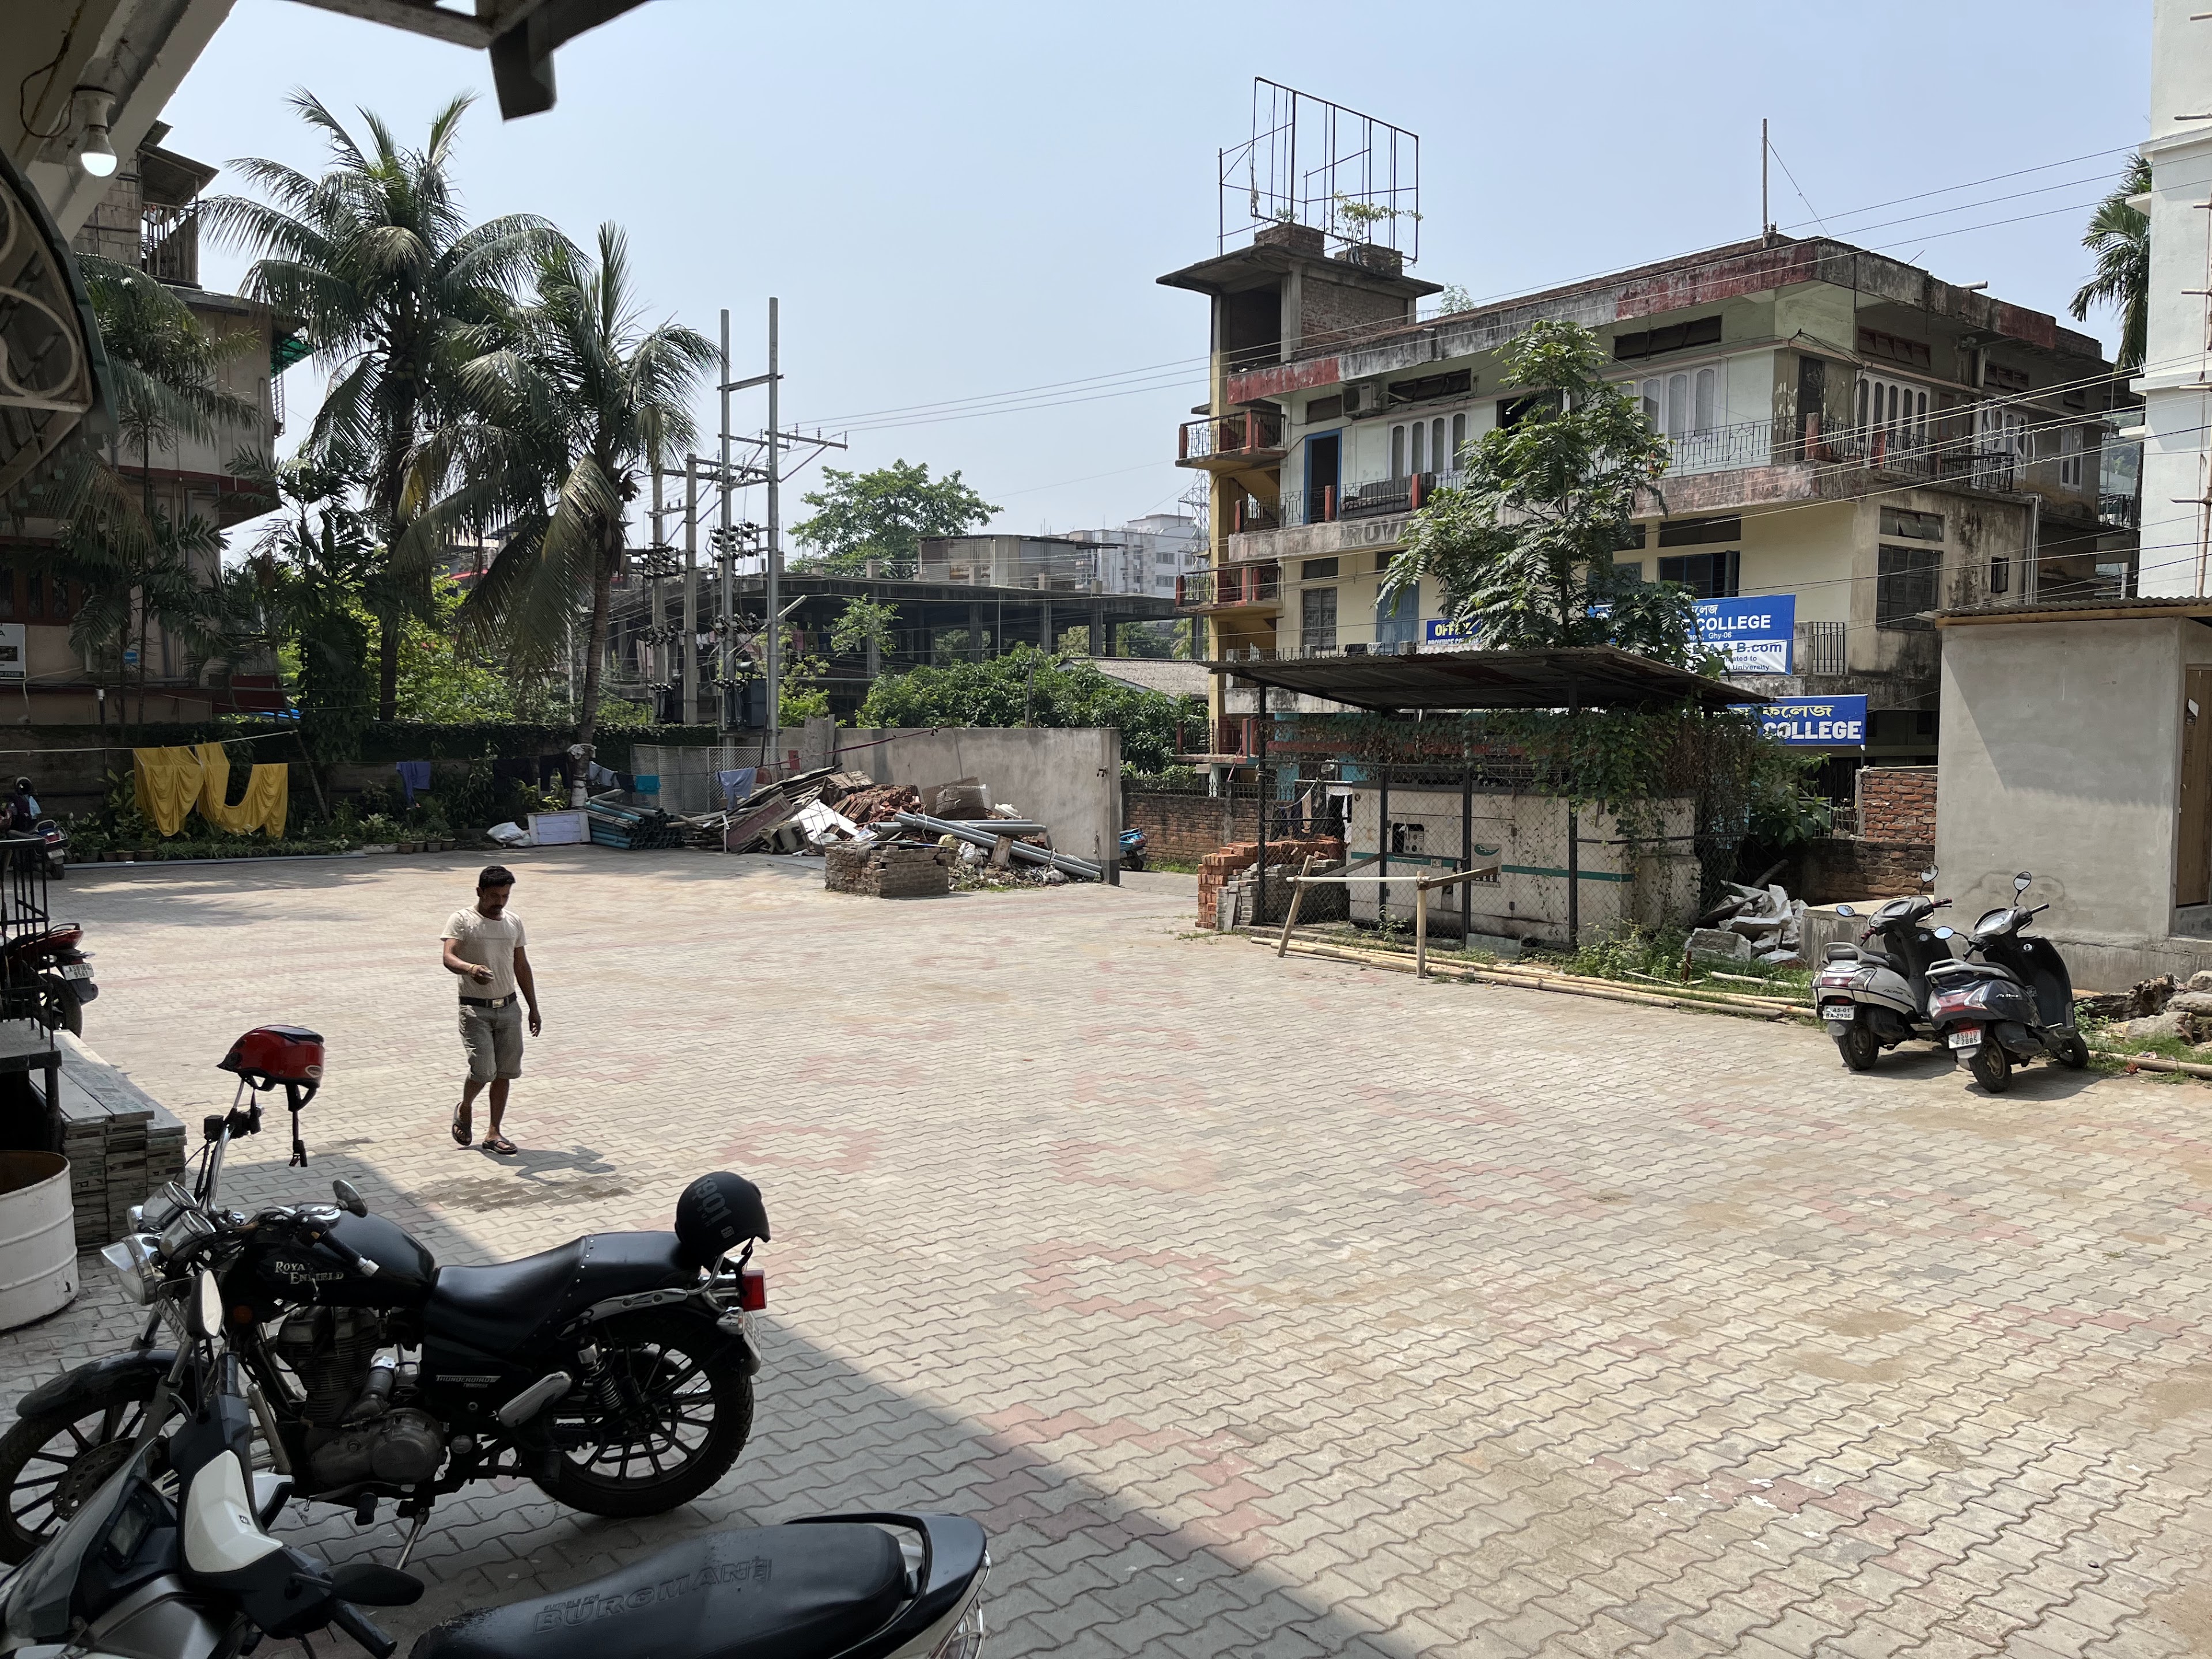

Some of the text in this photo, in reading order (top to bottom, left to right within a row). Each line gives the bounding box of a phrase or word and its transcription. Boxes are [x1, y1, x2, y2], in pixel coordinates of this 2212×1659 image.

[1696, 614, 1771, 632] COLLEGE
[1763, 721, 1862, 740] COLLEGE
[533, 1562, 751, 1633] BURGMAN
